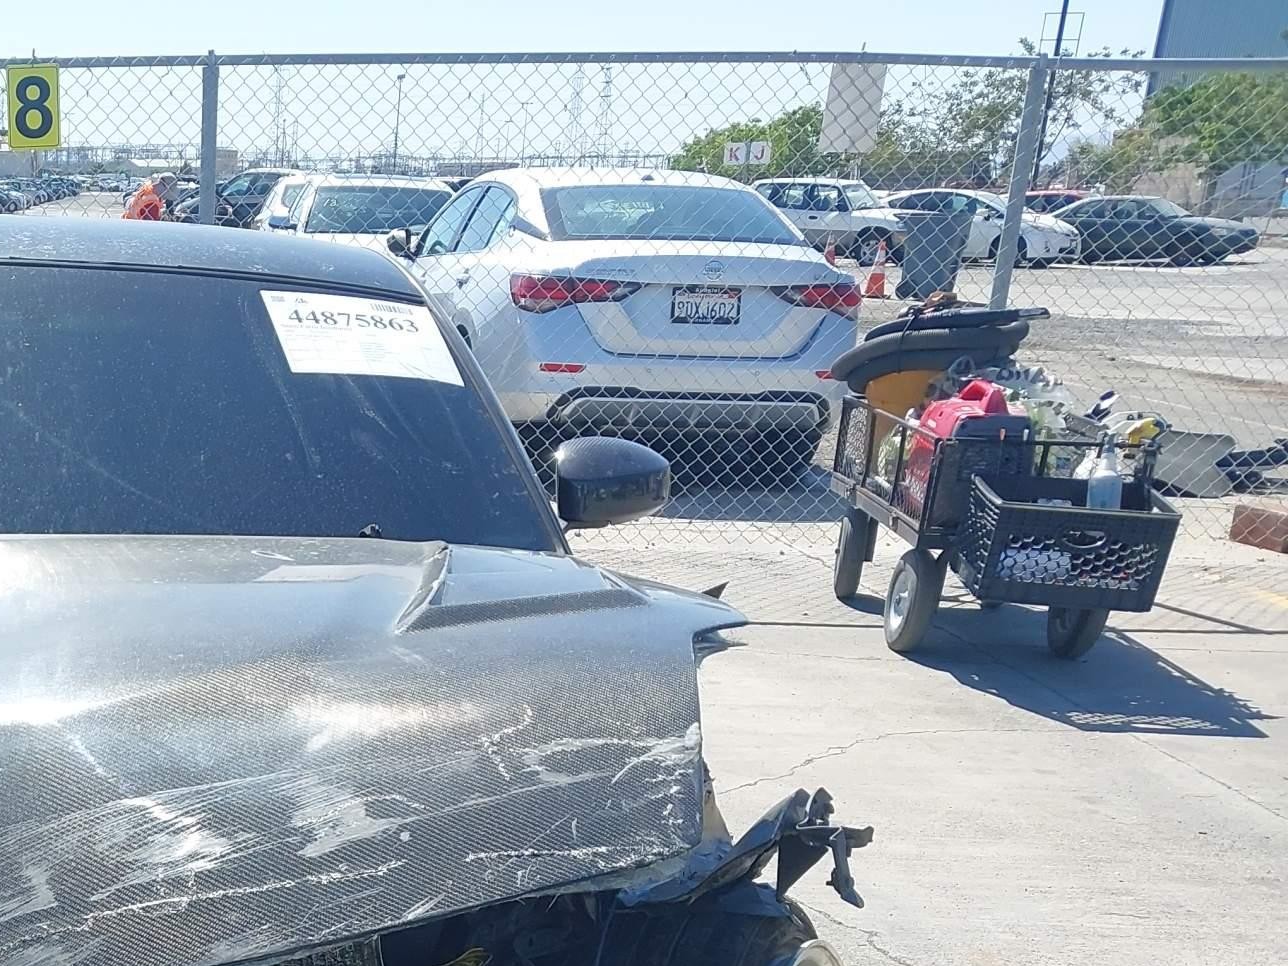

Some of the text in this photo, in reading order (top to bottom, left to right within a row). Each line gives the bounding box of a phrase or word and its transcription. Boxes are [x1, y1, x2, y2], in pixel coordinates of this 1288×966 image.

[15, 76, 53, 138] 8
[729, 147, 741, 161] K
[754, 146, 765, 160] J
[288, 308, 420, 333] 44875863
